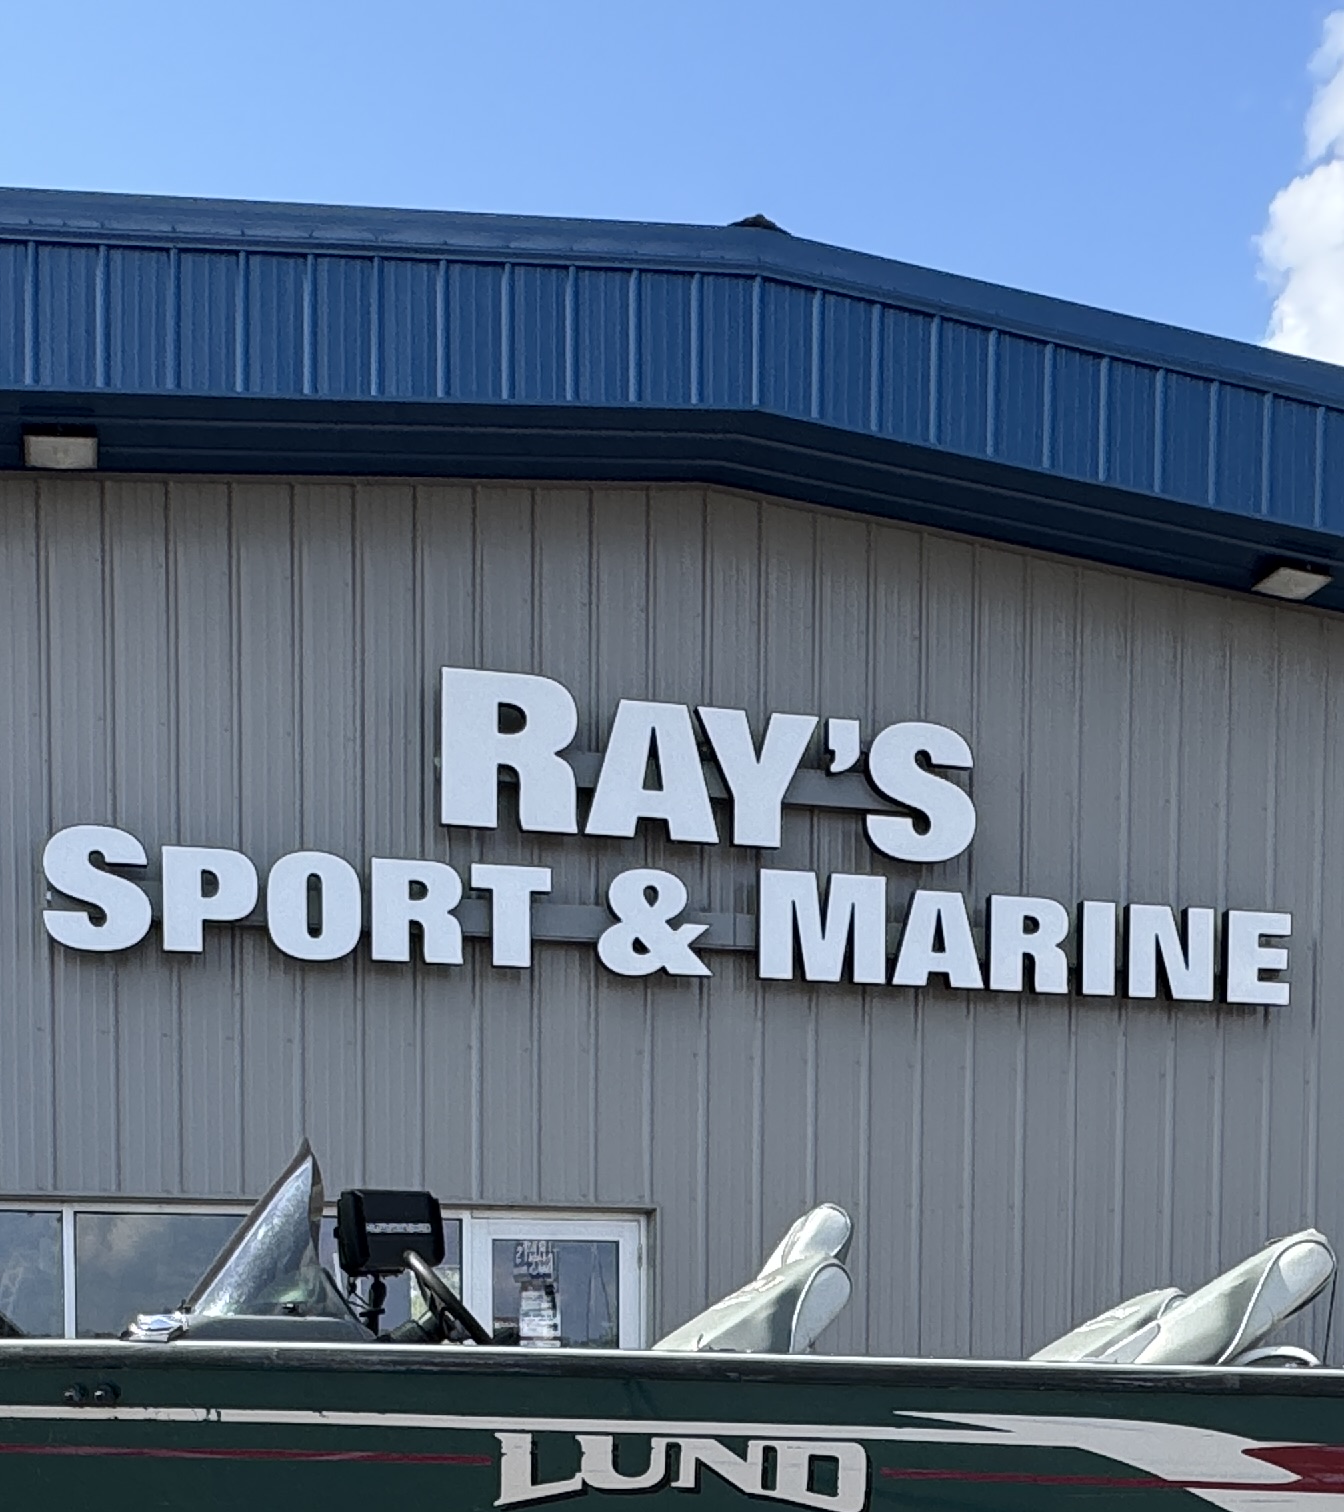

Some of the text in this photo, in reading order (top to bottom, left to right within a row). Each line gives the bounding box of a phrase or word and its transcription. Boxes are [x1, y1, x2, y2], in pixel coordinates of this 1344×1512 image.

[441, 666, 976, 862] RAY'S
[42, 823, 1293, 1006] SPORT & MARINE
